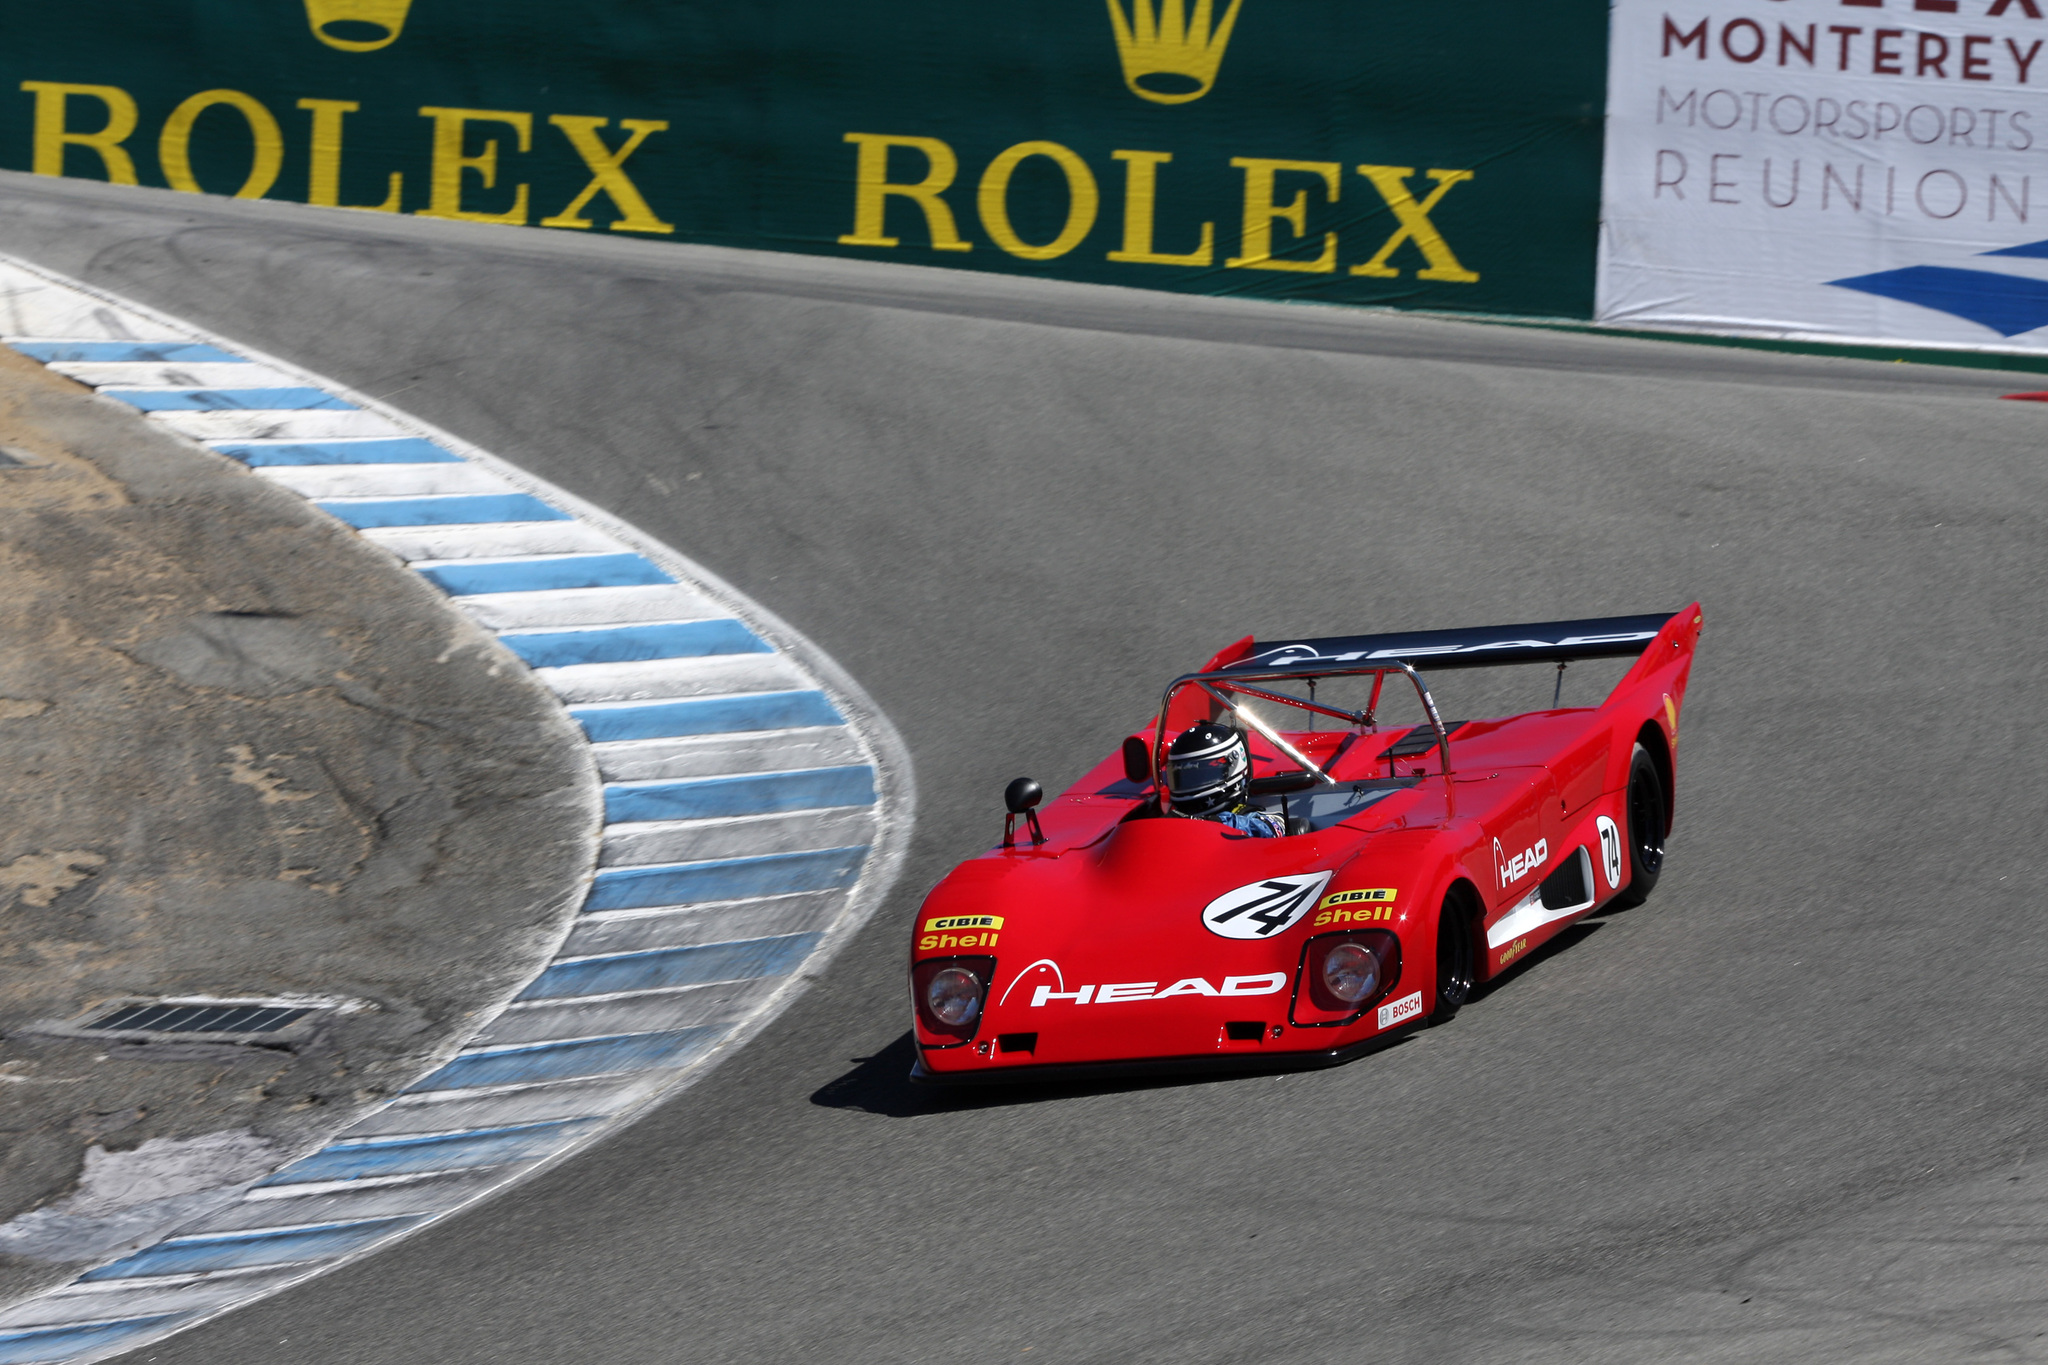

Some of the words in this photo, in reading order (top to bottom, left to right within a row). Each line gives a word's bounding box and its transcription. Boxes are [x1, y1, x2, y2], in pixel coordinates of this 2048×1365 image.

[1661, 12, 2045, 84] MONTEREY
[1656, 85, 2034, 151] MOTORSPORTS
[20, 80, 674, 233] ROLEX
[838, 132, 1480, 283] ROLEX
[1654, 149, 2030, 224] REUNION
[1500, 838, 1548, 888] HEAD
[1601, 825, 1620, 882] 74
[1213, 880, 1327, 935] 74
[1313, 906, 1393, 927] Shell
[918, 932, 999, 950] Shell
[1030, 972, 1286, 1007] HEAD
[1392, 996, 1420, 1018] BOSCH
